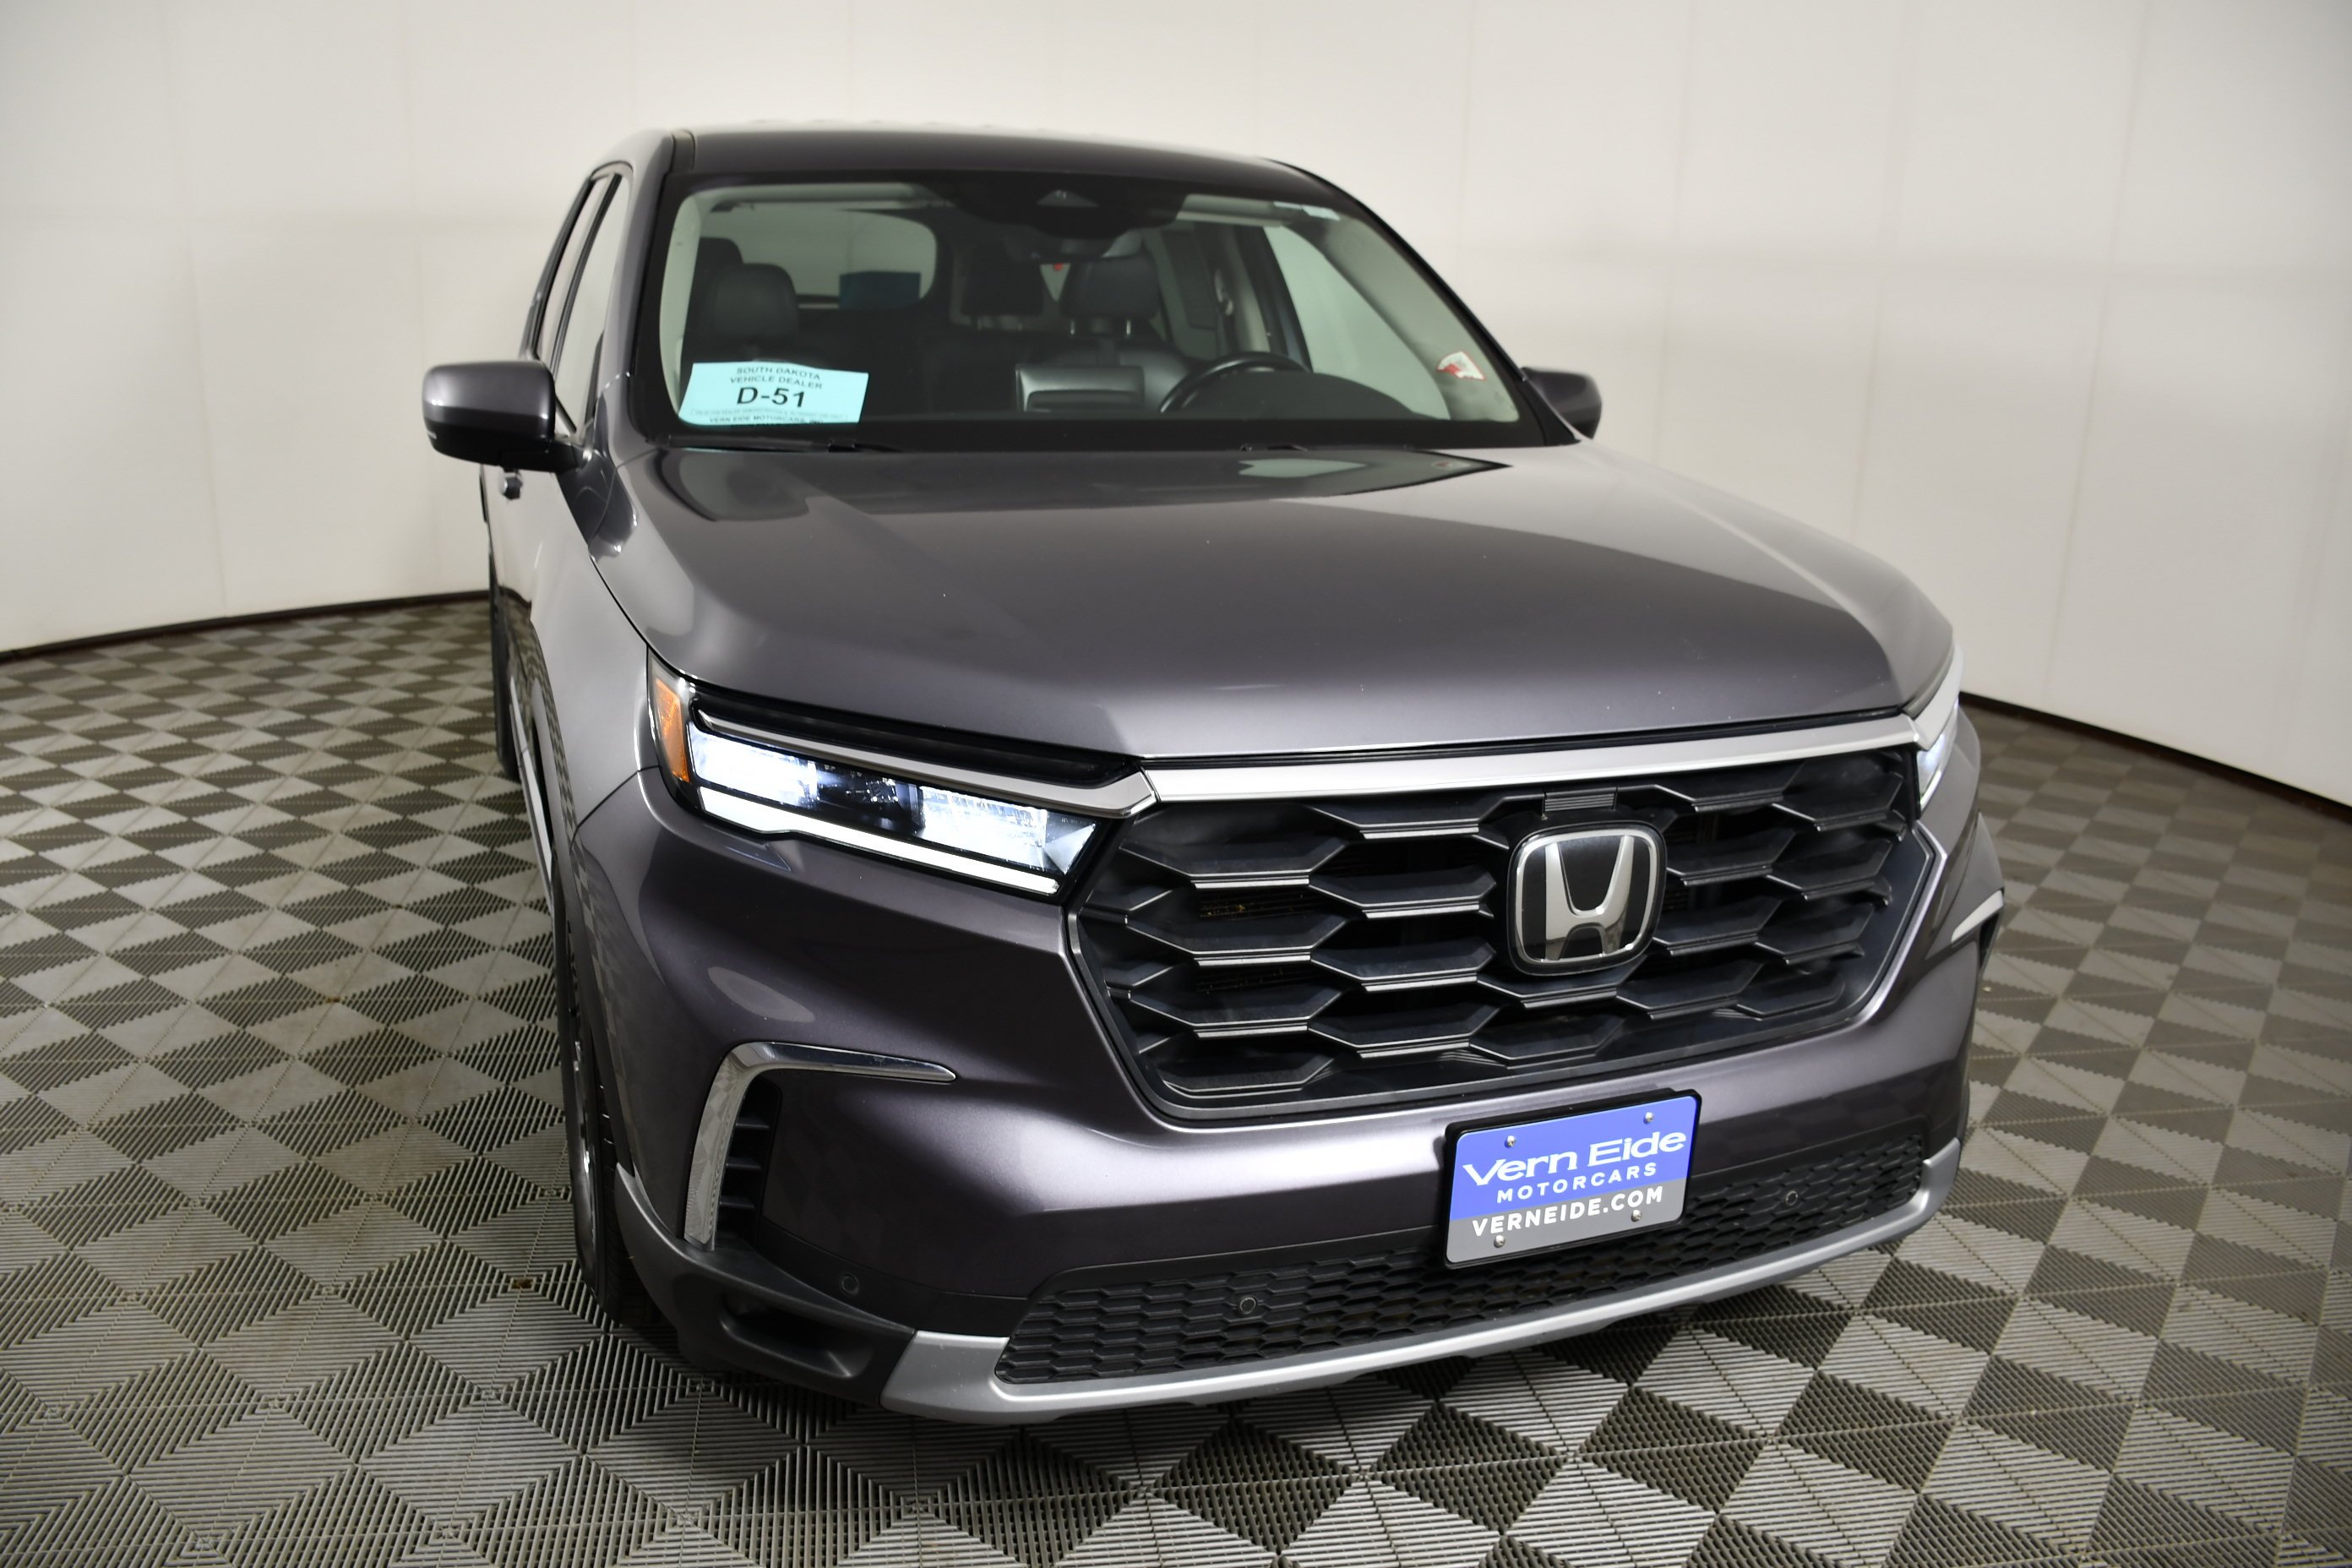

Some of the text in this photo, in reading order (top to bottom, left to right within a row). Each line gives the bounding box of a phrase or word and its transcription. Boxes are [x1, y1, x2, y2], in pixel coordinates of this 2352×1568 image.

[730, 375, 822, 389] VEHICLE DEALER
[737, 366, 820, 380] SOUTH DAKOTA
[737, 386, 805, 408] D-51
[1462, 1131, 1687, 1187] Vern Eide
[1496, 1162, 1657, 1204] MOTORCARS
[1472, 1185, 1663, 1237] VERNEIDE.COM
